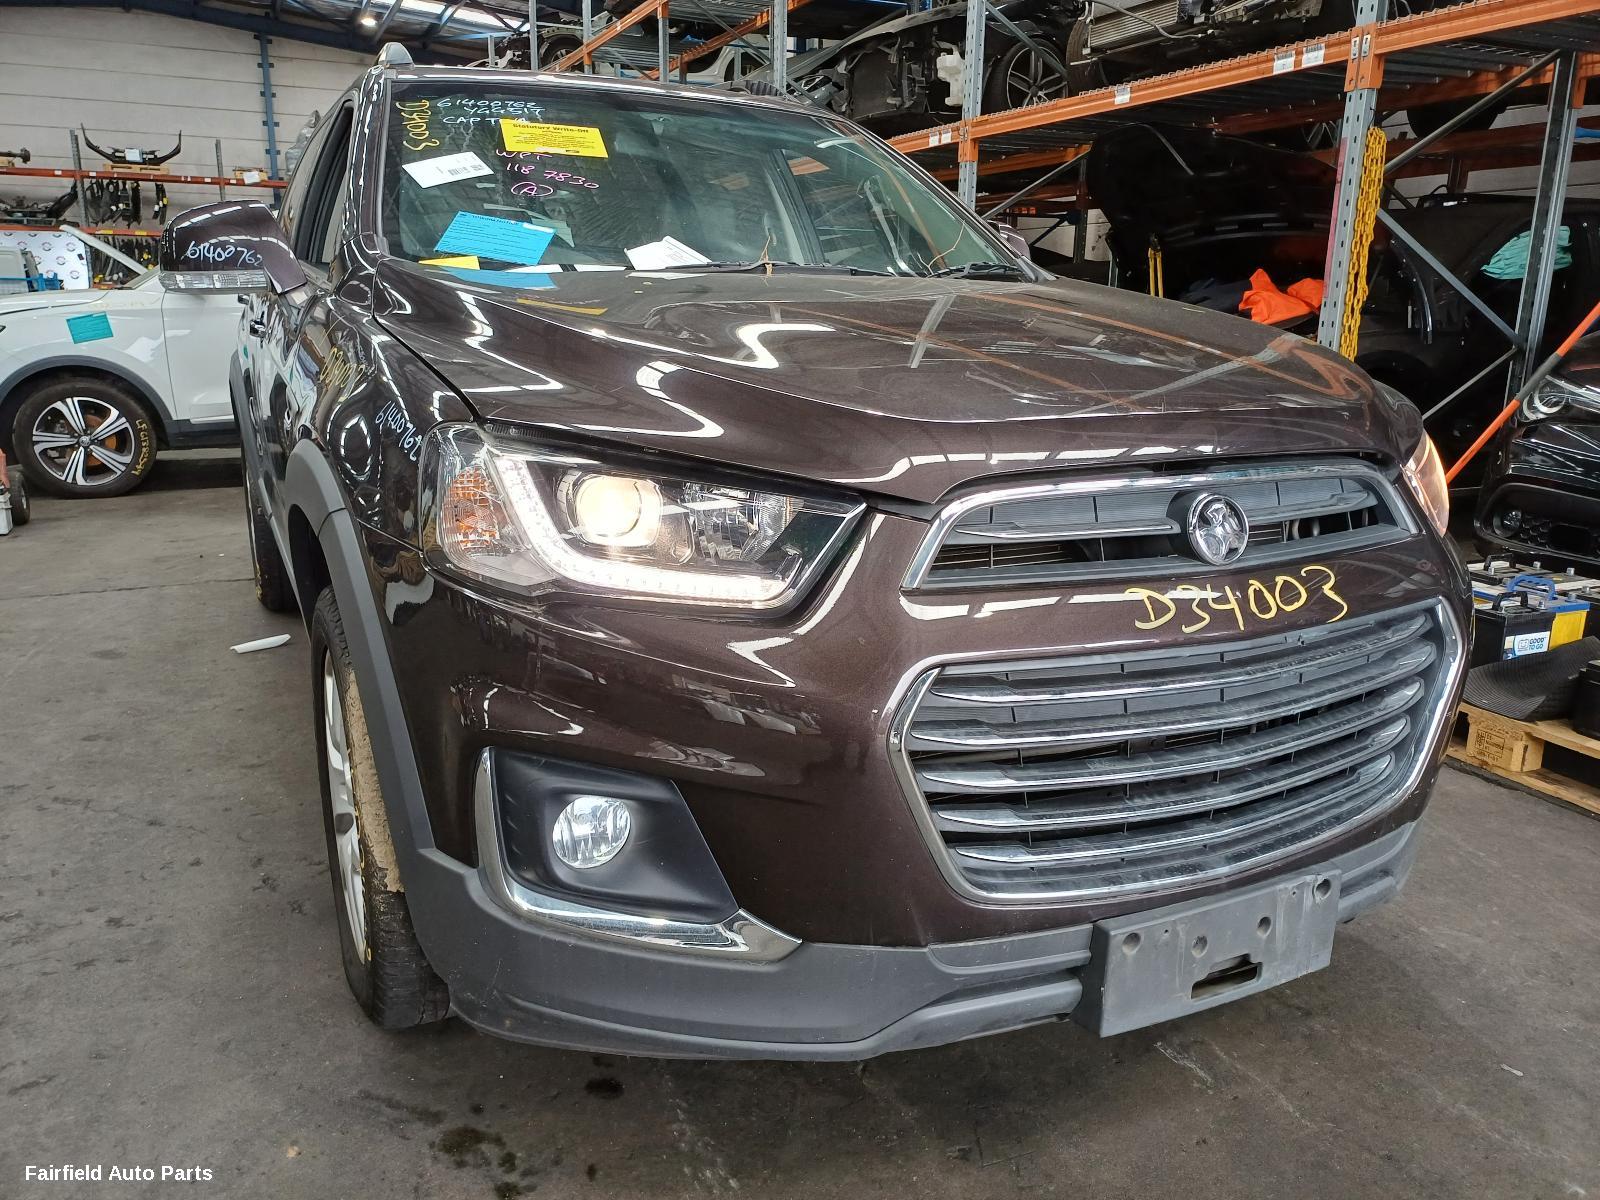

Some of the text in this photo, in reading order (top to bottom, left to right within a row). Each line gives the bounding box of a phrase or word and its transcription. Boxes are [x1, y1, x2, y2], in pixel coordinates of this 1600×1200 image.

[506, 162, 600, 189] 118 7830
[185, 240, 263, 267] 61400762
[375, 400, 423, 462] 61400762
[1124, 565, 1348, 634] D34003
